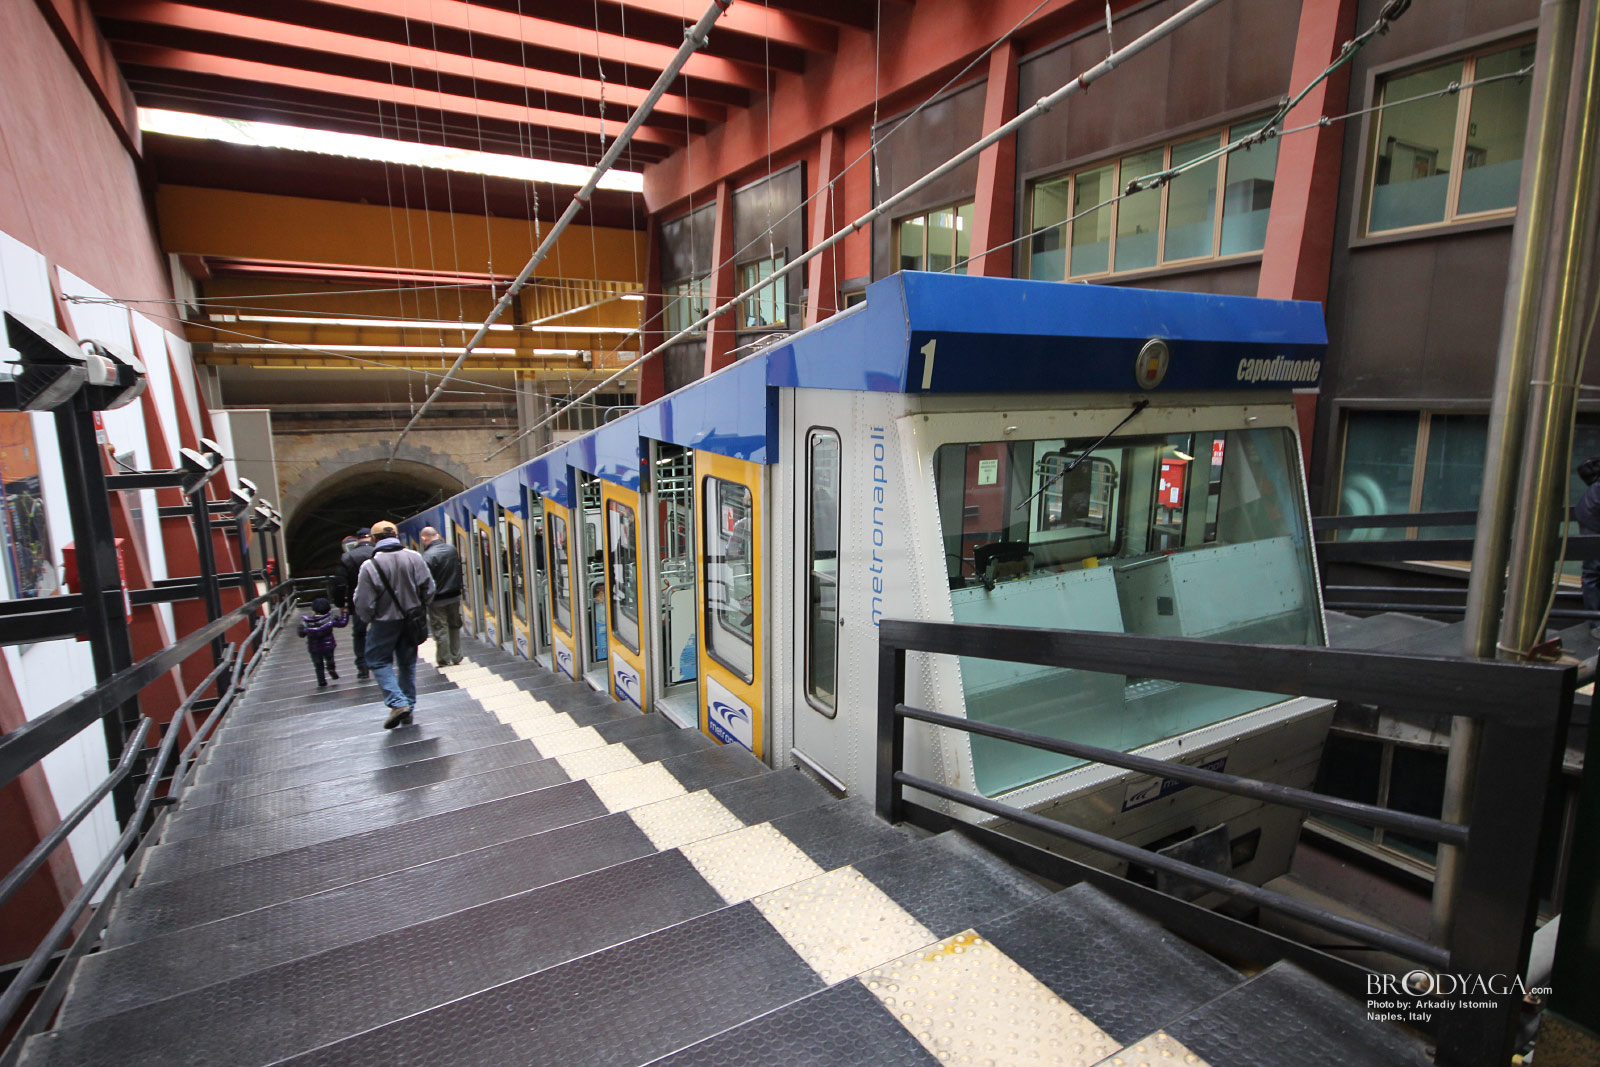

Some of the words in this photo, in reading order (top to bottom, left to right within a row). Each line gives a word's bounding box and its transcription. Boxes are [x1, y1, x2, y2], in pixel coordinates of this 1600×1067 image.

[920, 338, 937, 390] 1
[1236, 355, 1321, 384] capodimonte
[869, 426, 888, 627] metronapoli
